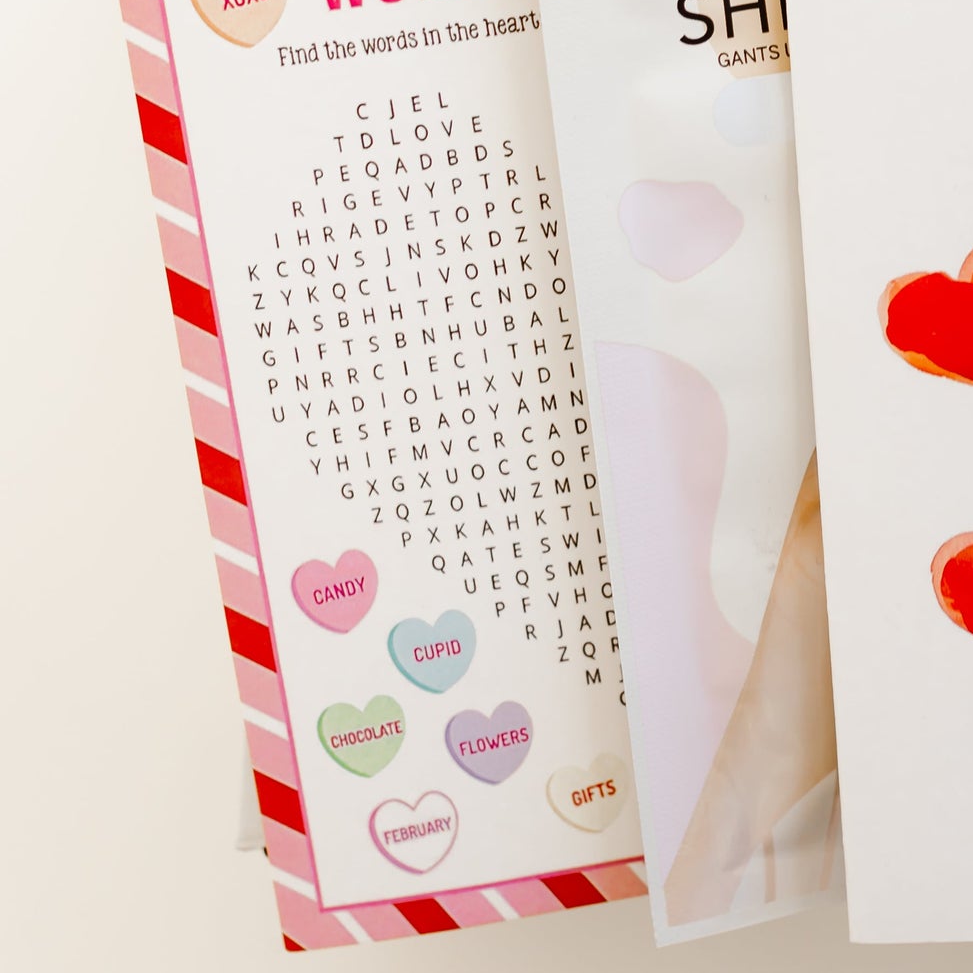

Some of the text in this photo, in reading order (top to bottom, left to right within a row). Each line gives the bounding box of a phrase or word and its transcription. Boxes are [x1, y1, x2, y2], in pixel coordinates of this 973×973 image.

[278, 44, 319, 66] Find
[324, 40, 356, 60] the
[362, 31, 418, 55] words
[423, 27, 442, 45] in
[446, 22, 479, 42] the
[717, 44, 780, 68] GANTS
[313, 576, 366, 605] CANDY
[414, 639, 462, 662] CUPID
[331, 720, 403, 749] CHOCOLATE
[459, 727, 529, 756] FLOWERS
[572, 779, 616, 806] GIFTS
[384, 817, 451, 844] FEBRUARY
